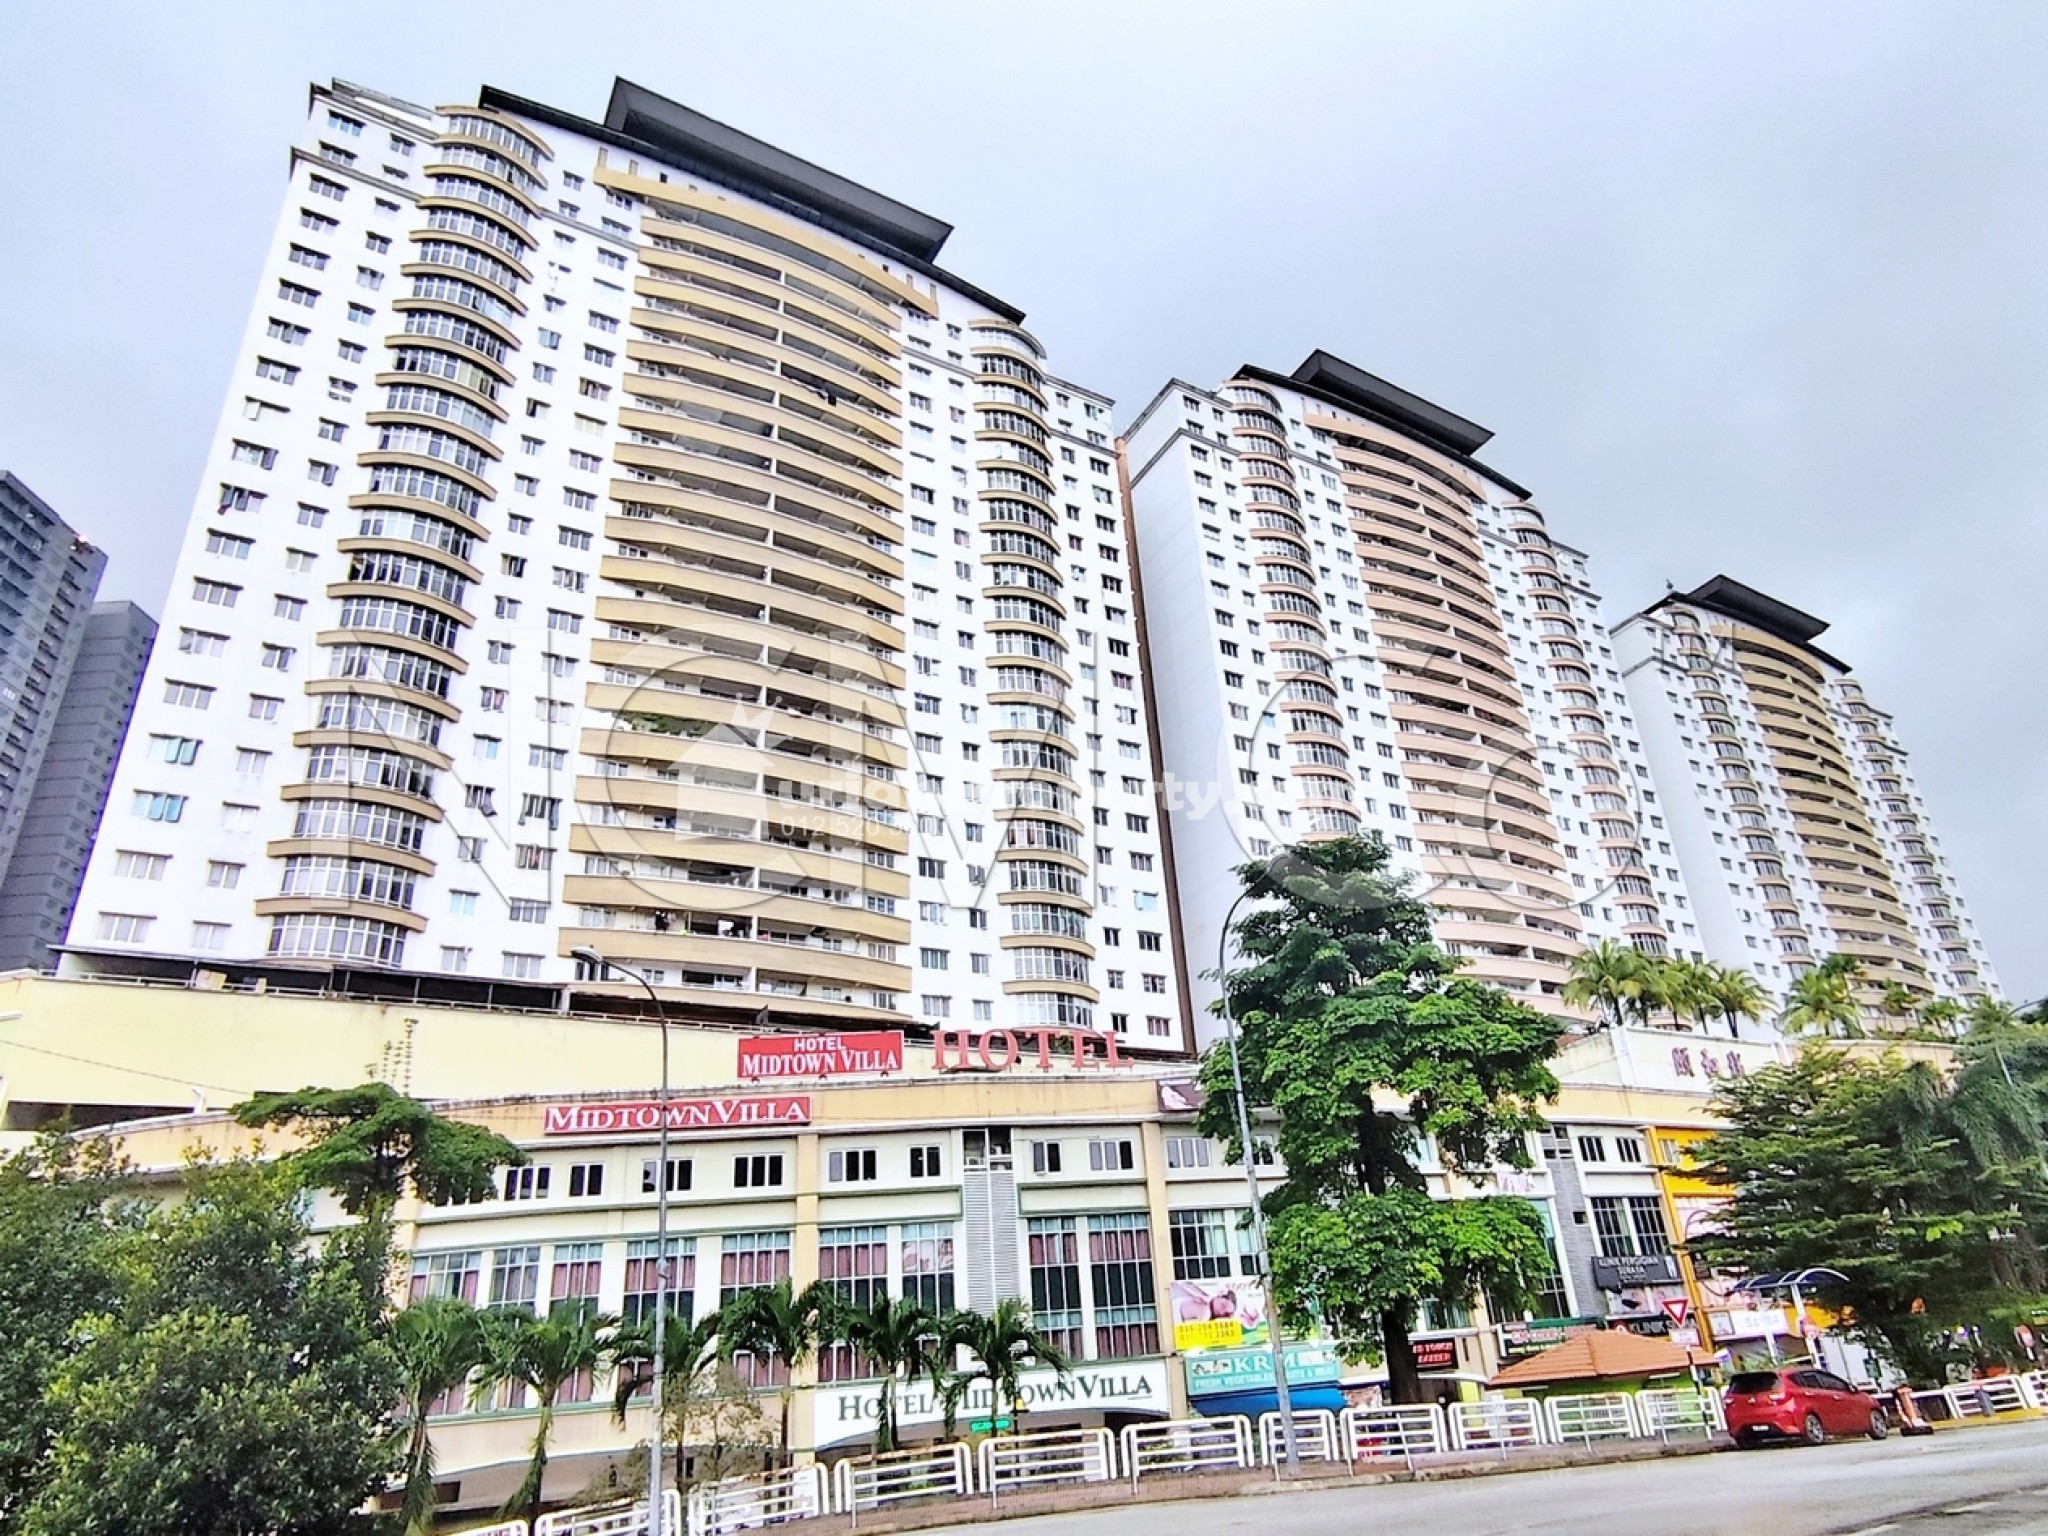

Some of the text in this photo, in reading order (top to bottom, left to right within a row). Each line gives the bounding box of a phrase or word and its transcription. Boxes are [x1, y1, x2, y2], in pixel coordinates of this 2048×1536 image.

[793, 1037, 847, 1052] HOTEL
[931, 1028, 1134, 1071] HOTEL
[742, 1049, 898, 1076] MIDTOWN VILLA
